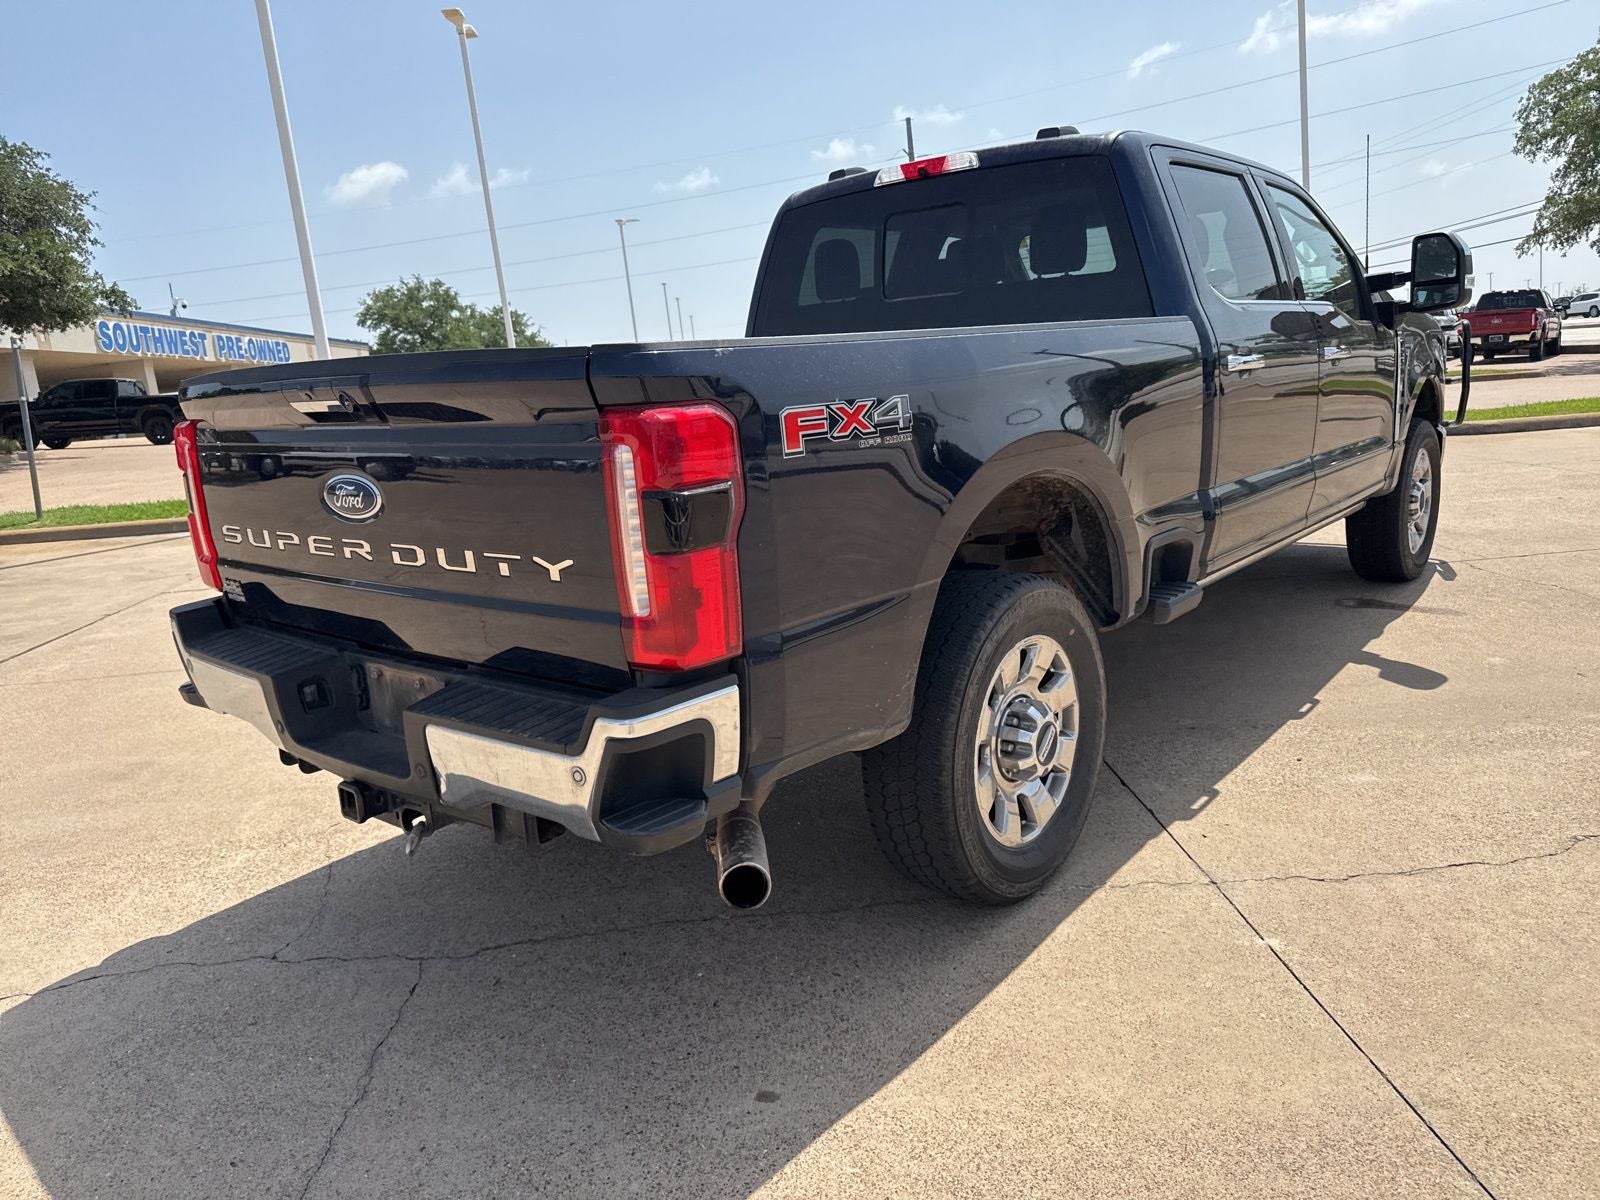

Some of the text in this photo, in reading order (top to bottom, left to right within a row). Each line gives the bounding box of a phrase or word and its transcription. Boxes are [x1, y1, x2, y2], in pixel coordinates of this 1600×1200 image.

[97, 319, 291, 363] SOUTHWEST PRE-OWNED
[779, 394, 913, 459] FX4
[858, 437, 882, 449] OFF
[333, 483, 365, 509] Ford
[222, 524, 575, 582] SUPER DUTY
